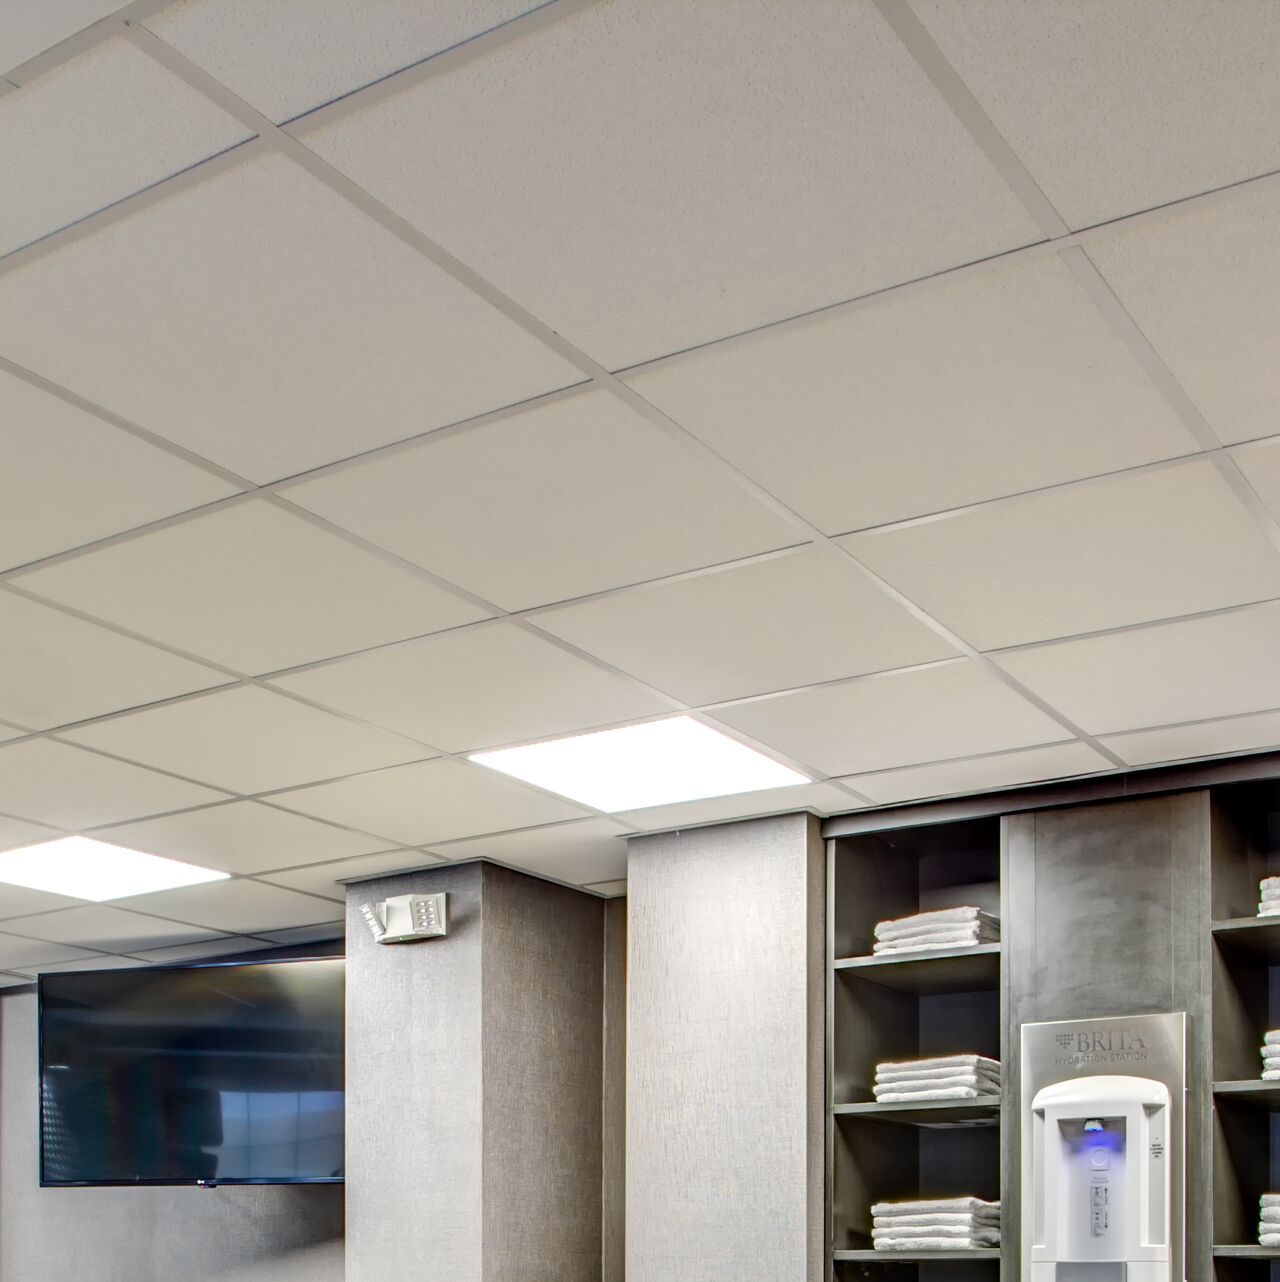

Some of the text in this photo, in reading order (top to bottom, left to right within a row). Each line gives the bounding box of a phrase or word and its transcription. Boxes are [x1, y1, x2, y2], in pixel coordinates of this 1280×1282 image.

[1076, 1029, 1146, 1053] BRITA
[1055, 1052, 1148, 1065] HYDRATION STATION
